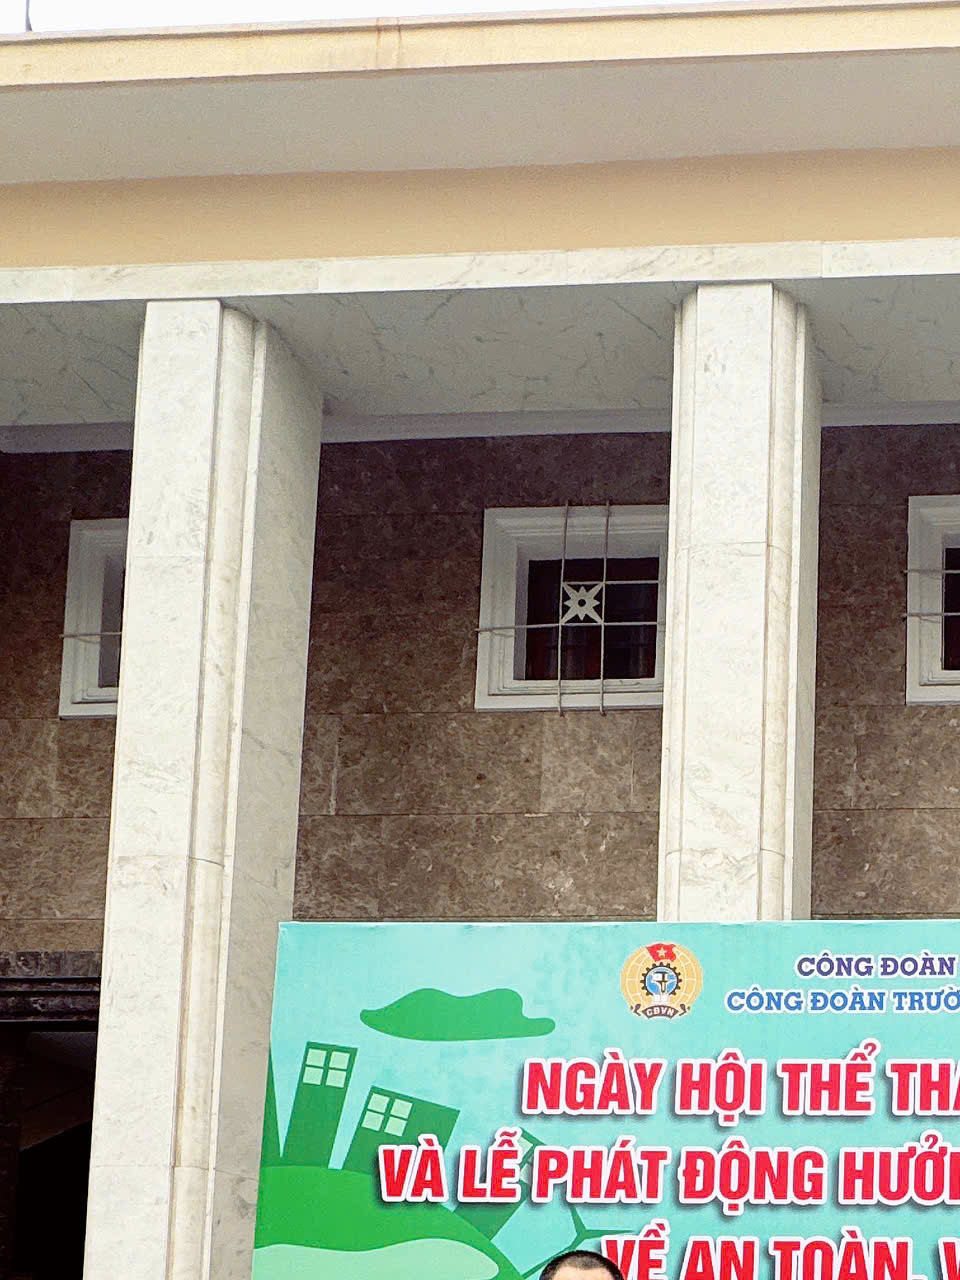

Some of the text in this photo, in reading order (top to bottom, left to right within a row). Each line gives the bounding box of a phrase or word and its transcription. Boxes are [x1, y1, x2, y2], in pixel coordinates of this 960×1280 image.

[797, 953, 874, 977] CÔNG
[880, 952, 956, 976] ĐOÀN
[727, 987, 804, 1011] CÔNG
[810, 986, 886, 1011] ĐOÀN
[526, 1052, 662, 1111] NGÀY
[679, 1053, 763, 1122] HỘI
[780, 1042, 877, 1111] THỂ
[382, 1138, 443, 1198] VÀ
[462, 1130, 517, 1198] LỄ
[535, 1140, 667, 1199] PHÁT
[682, 1140, 824, 1211] ĐỘNG
